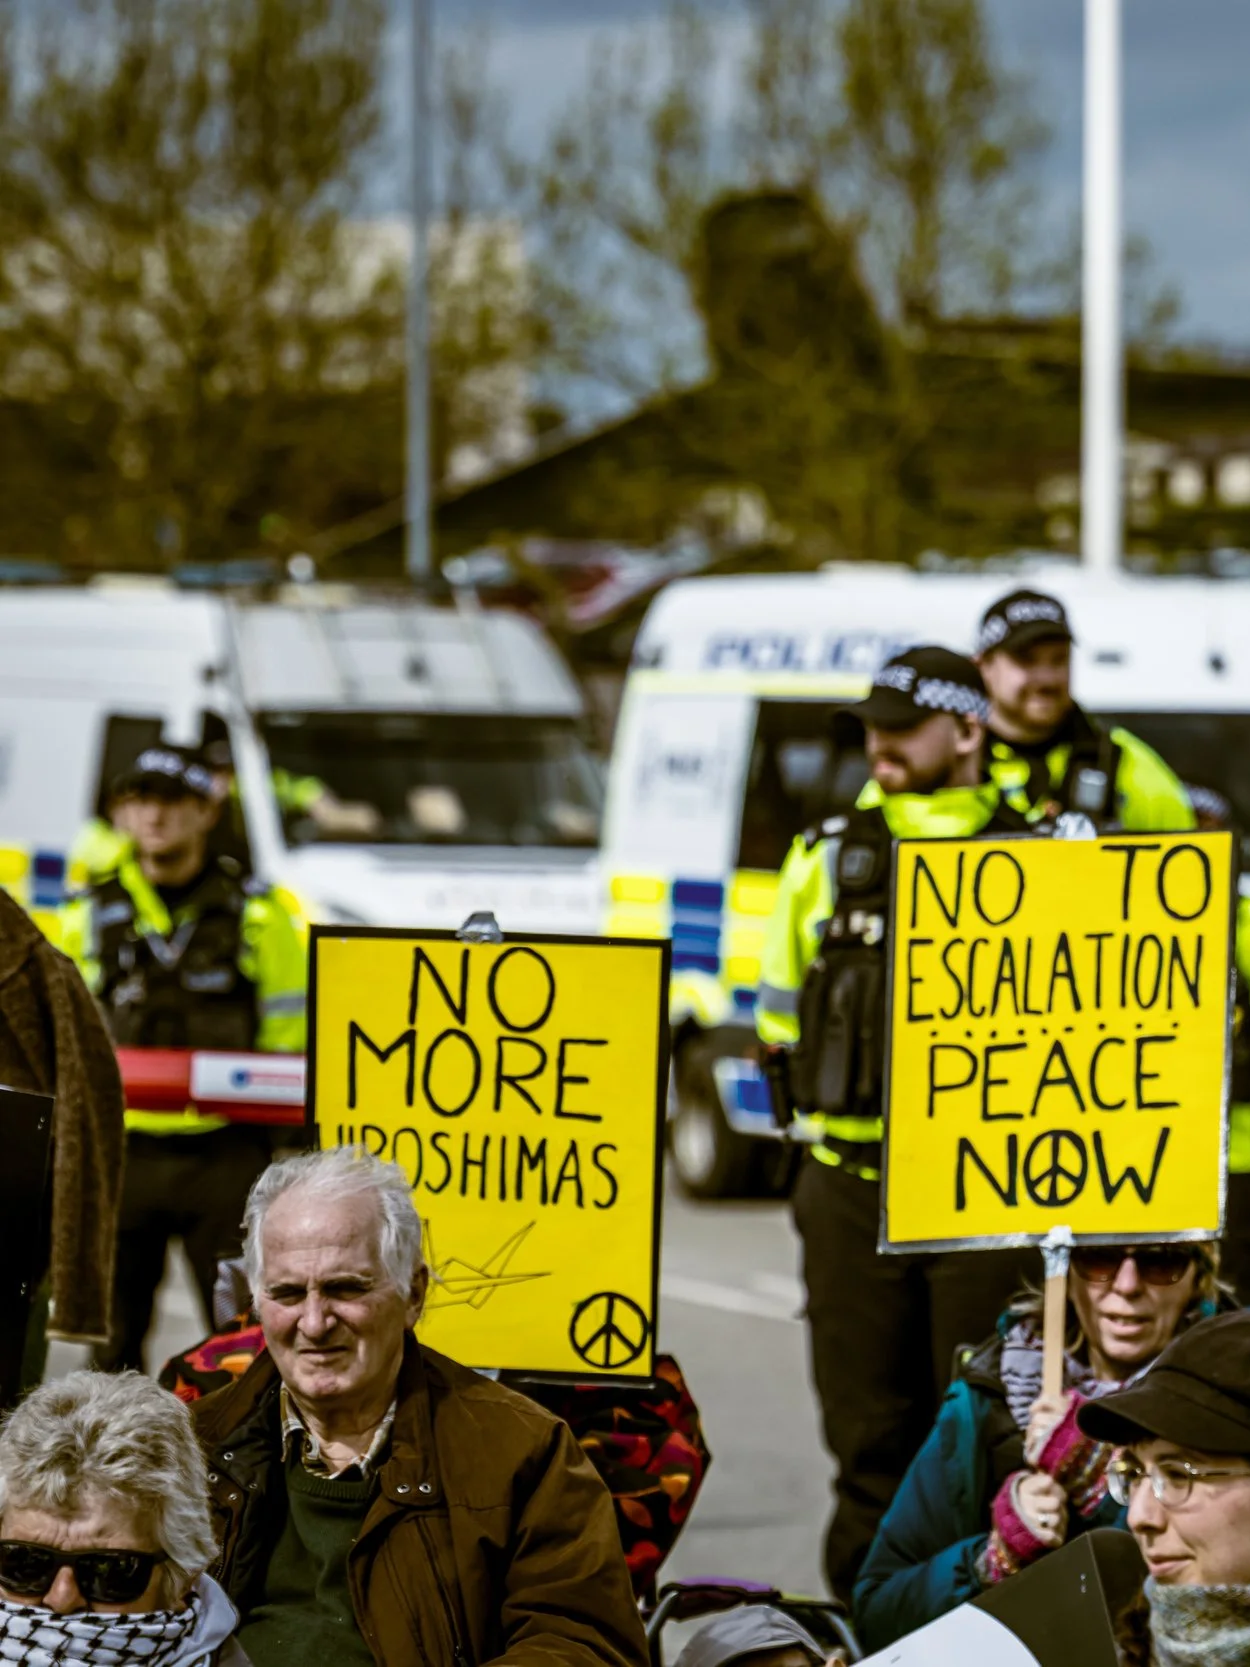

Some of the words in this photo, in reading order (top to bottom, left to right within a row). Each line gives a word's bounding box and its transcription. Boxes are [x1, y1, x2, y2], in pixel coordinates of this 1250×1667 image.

[911, 850, 1025, 929] NO
[1101, 843, 1212, 922] TO
[407, 946, 556, 1034] NO
[907, 931, 1203, 1023] ESCALATION
[347, 1020, 609, 1123] MORE
[927, 1036, 1180, 1122] PEACE
[314, 1122, 619, 1210] OSHIMAS
[955, 1126, 1171, 1212] NOW
